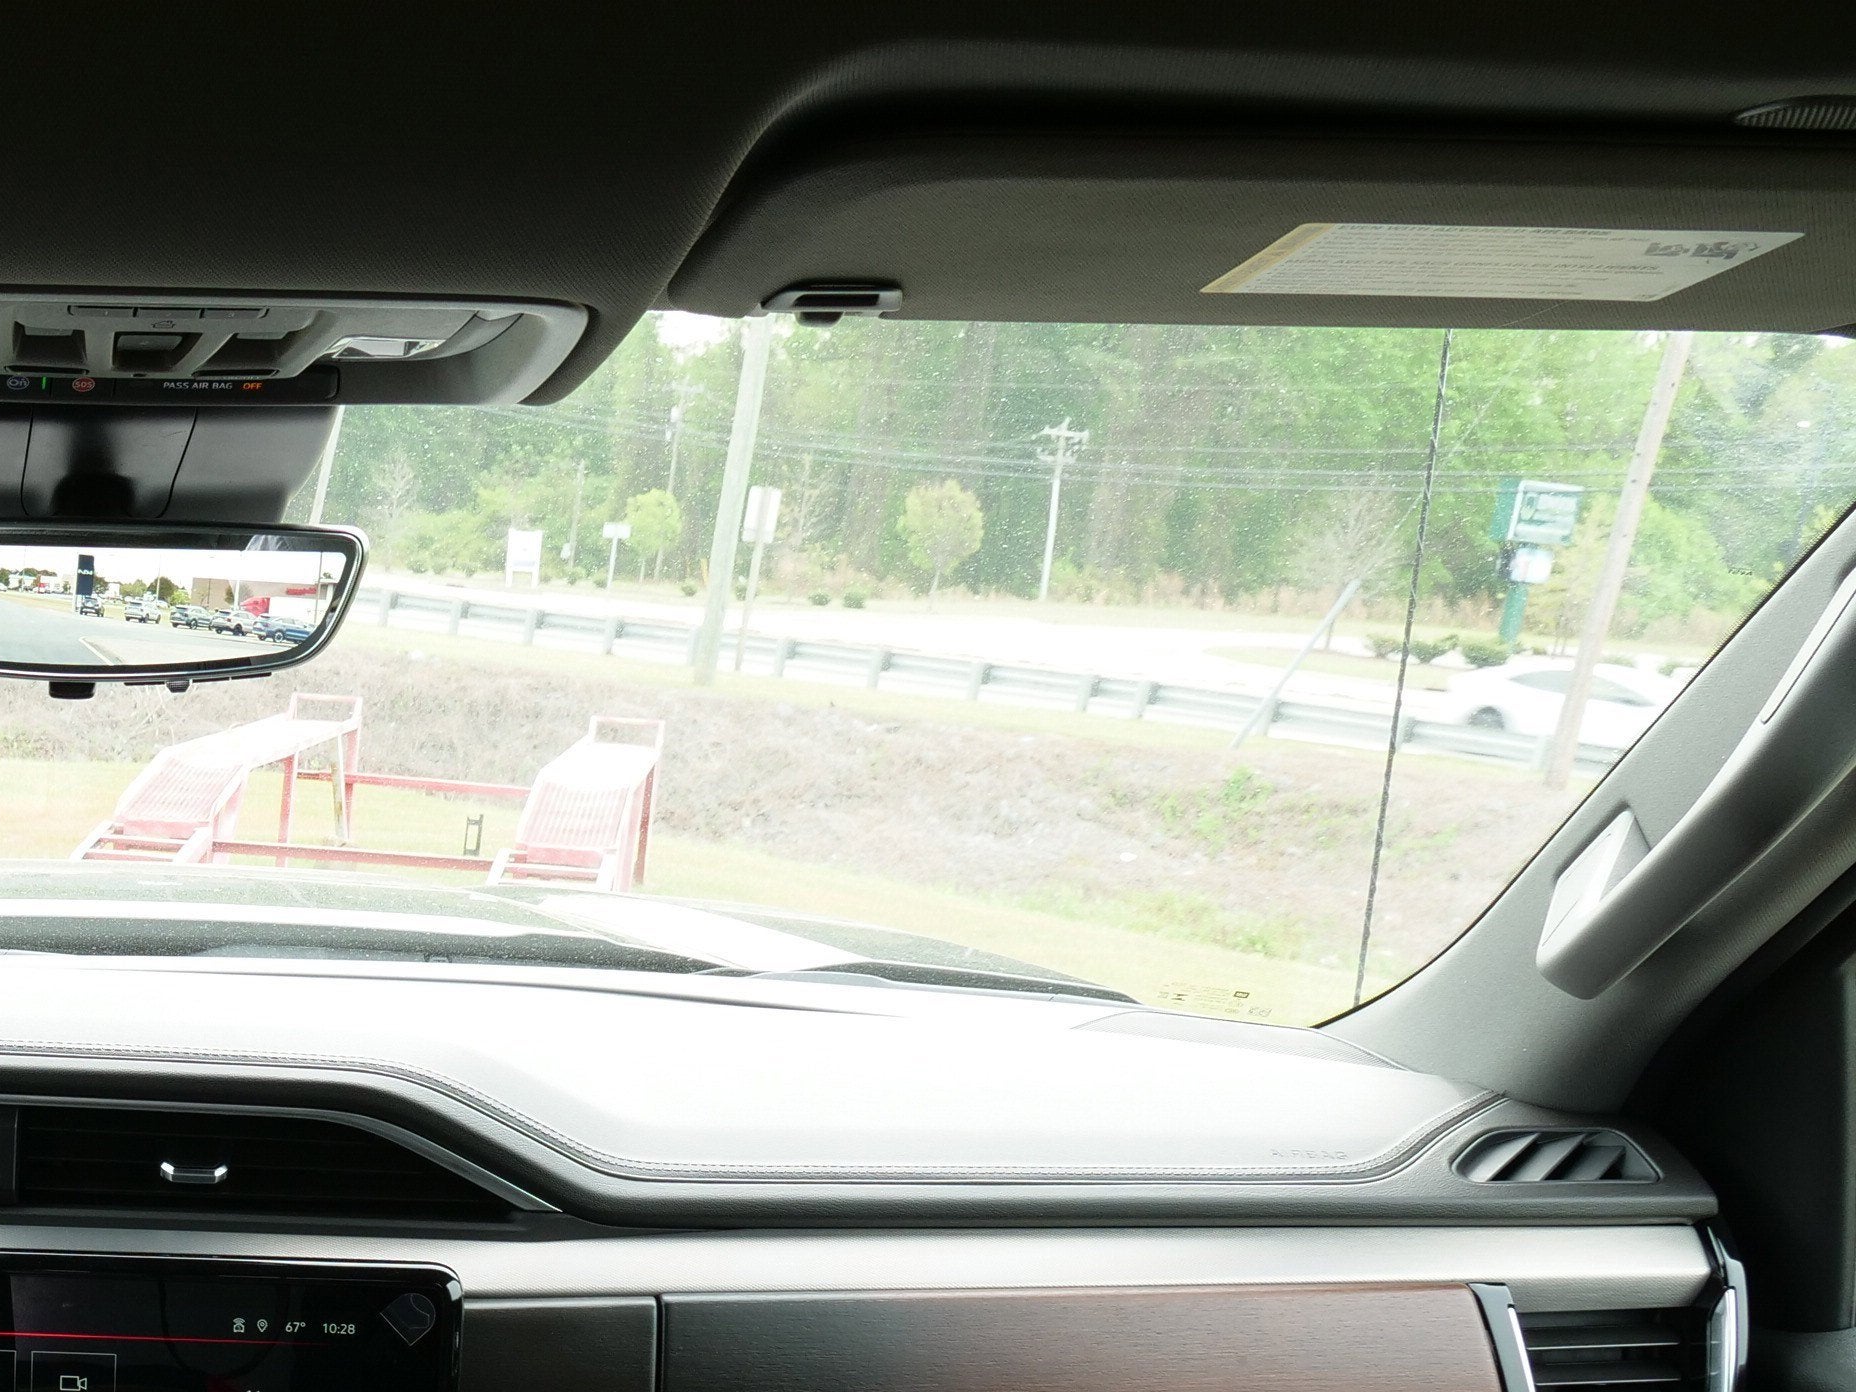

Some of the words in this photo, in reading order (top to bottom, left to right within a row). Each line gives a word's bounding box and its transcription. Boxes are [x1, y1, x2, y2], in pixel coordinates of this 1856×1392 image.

[73, 380, 94, 389] SOS
[163, 381, 190, 390] PASS
[192, 381, 211, 390] AIR
[212, 382, 233, 390] BAG
[243, 382, 263, 391] OFF
[285, 1321, 307, 1333] 67°
[322, 1323, 355, 1335] 10:28
